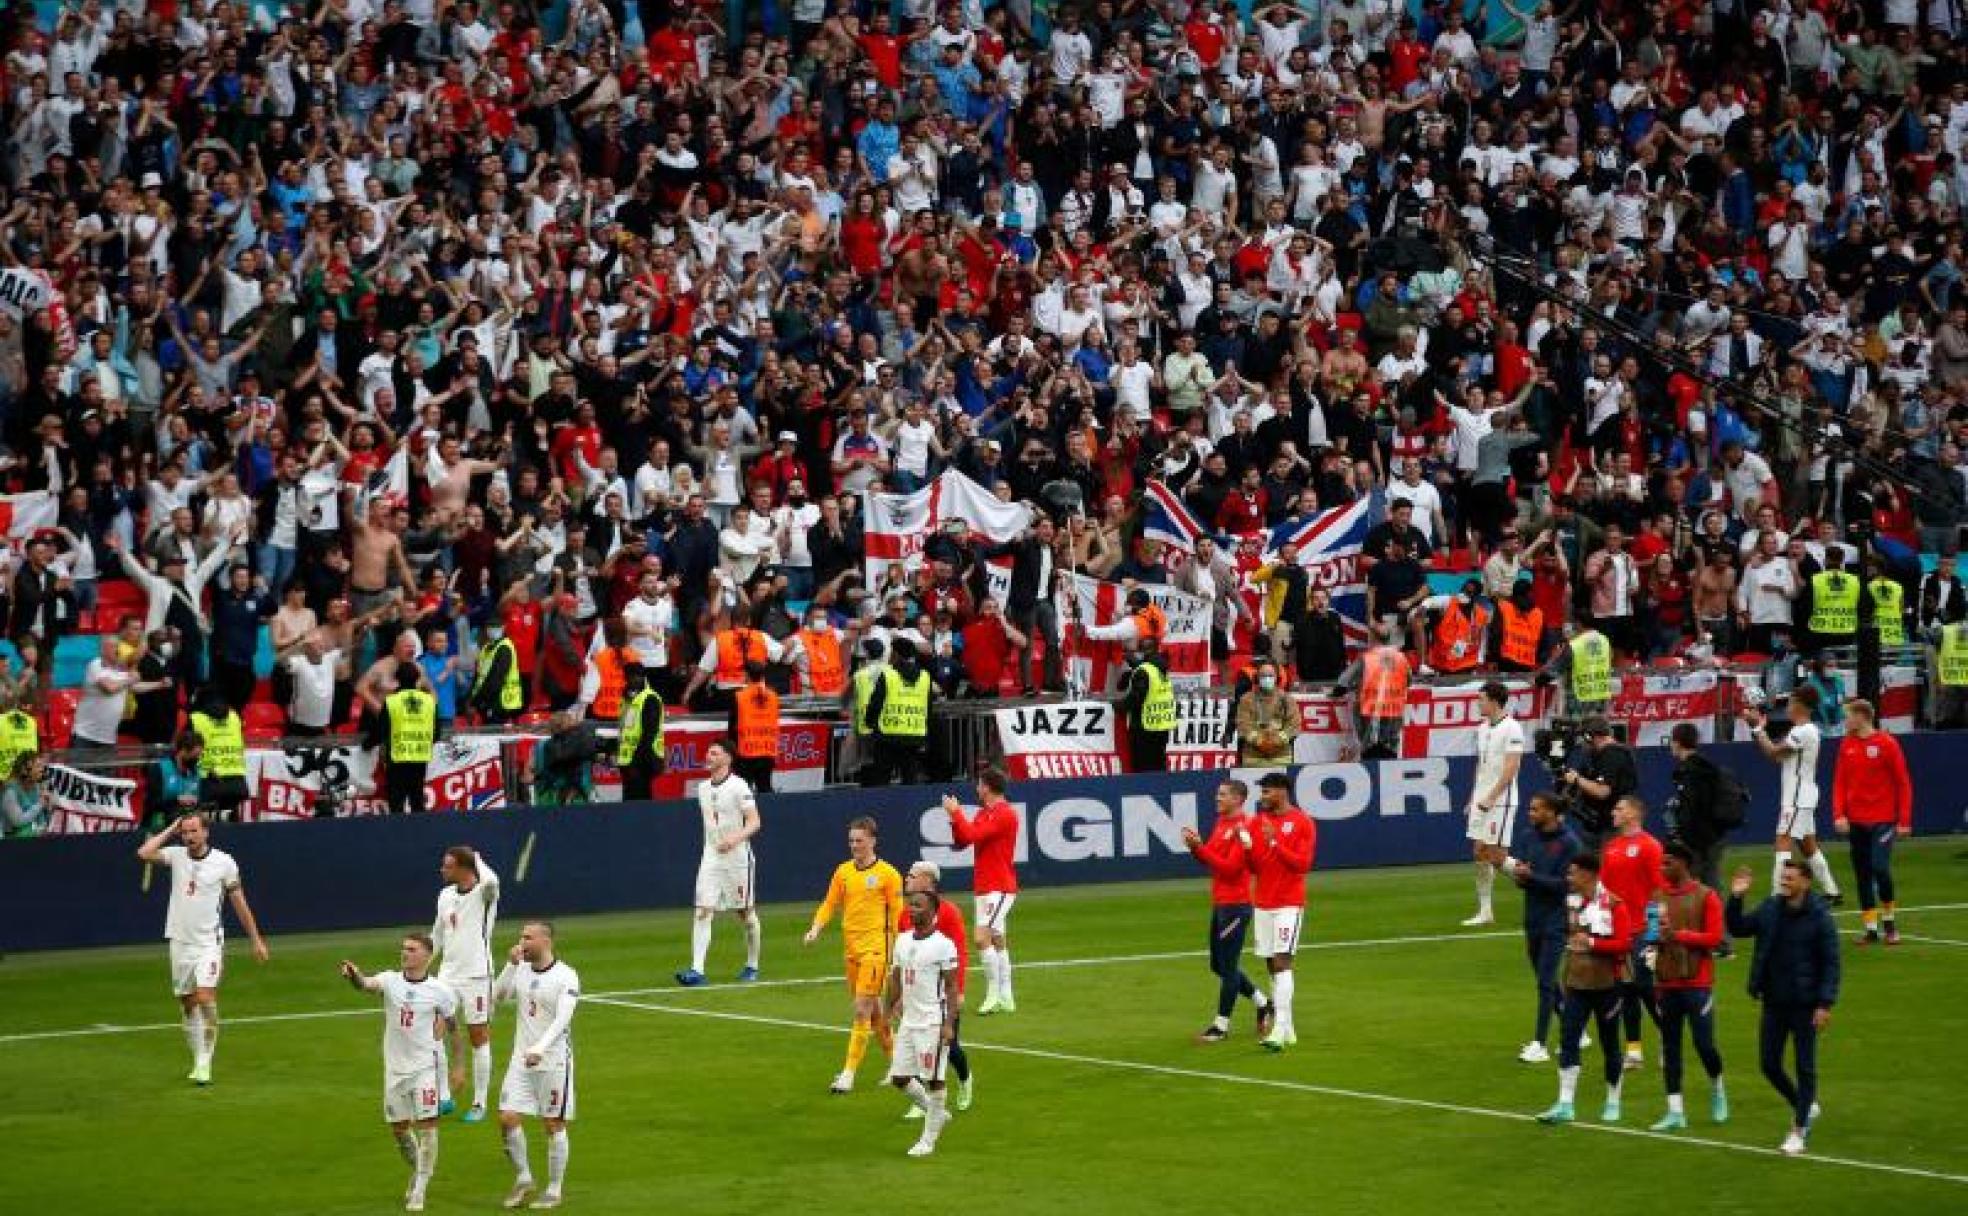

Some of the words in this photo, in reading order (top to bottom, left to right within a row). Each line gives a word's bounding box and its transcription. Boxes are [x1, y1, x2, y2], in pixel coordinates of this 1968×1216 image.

[1010, 708, 1106, 736] JAZZ
[1172, 722, 1234, 745] LADE
[1168, 755, 1205, 771] TED
[400, 1010, 415, 1027] 12
[422, 1089, 436, 1105] 12
